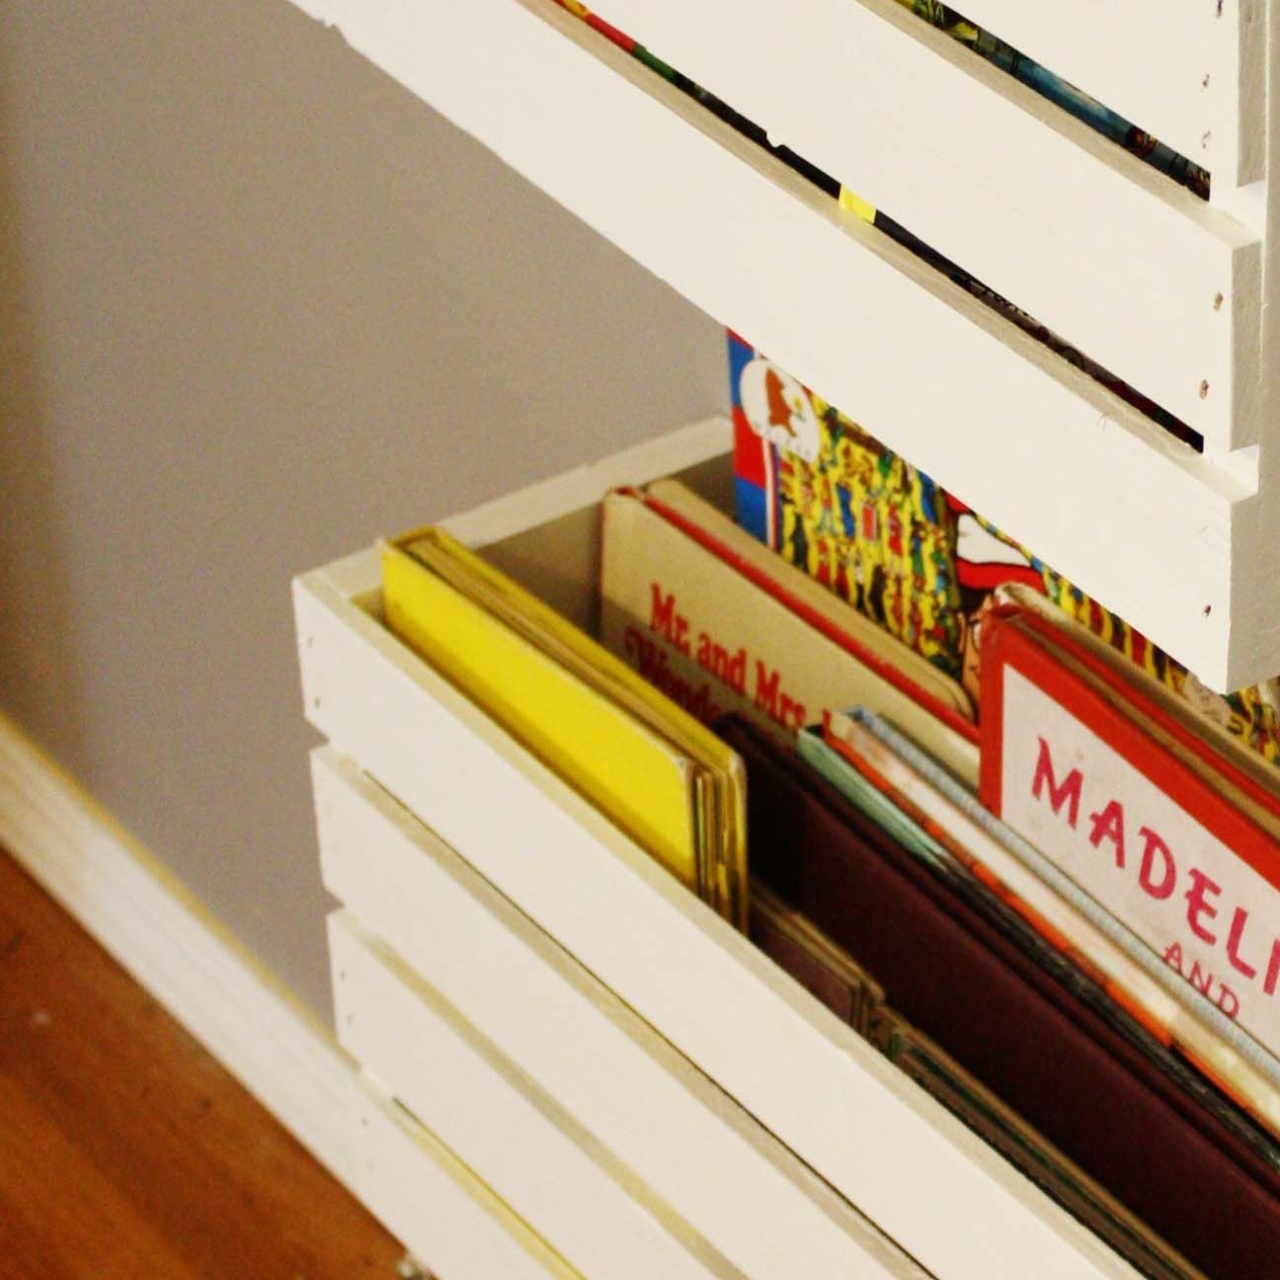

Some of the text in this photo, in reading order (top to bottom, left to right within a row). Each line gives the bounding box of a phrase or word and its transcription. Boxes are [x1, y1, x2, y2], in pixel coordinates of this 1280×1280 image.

[650, 582, 691, 658] Mr.
[697, 632, 747, 697] and
[1162, 942, 1241, 1020] AND
